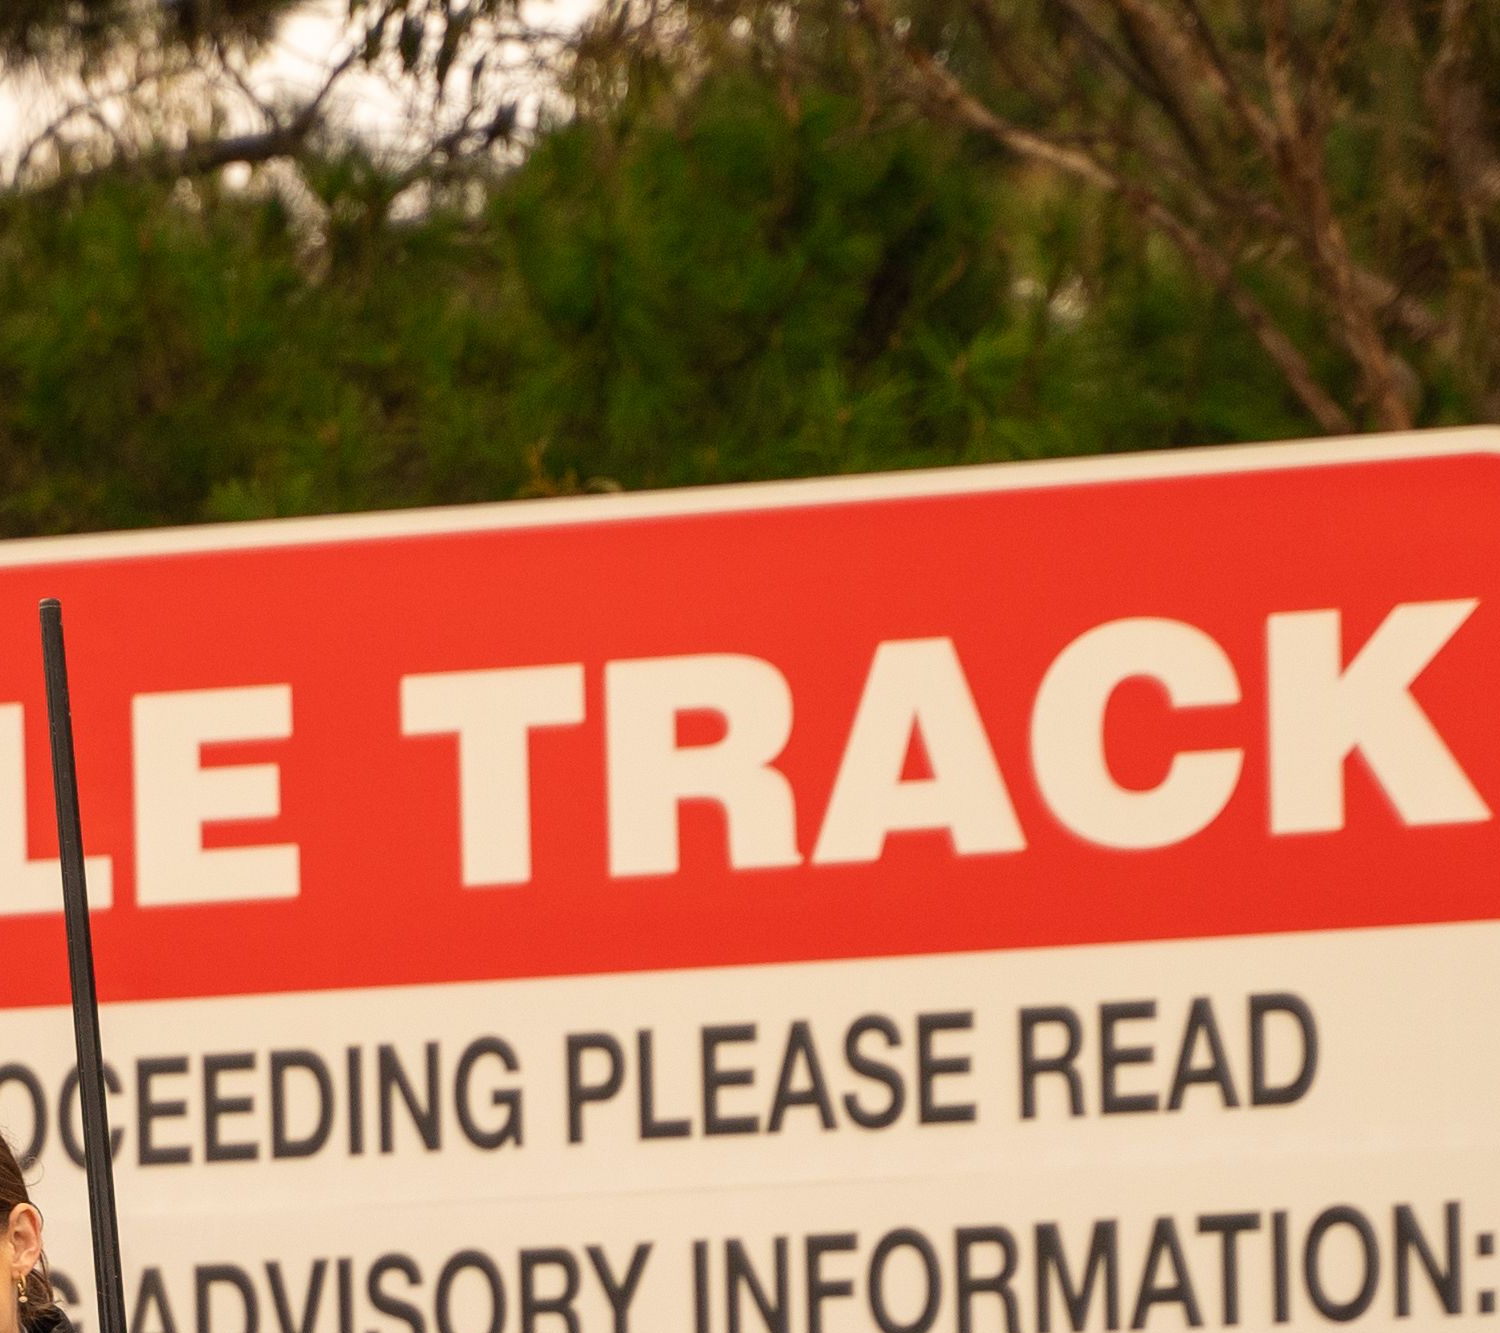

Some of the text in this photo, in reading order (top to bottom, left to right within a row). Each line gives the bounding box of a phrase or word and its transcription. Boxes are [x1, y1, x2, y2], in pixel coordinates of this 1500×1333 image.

[400, 598, 1492, 888] TRACK
[565, 1010, 978, 1142] PLEASE
[1017, 992, 1320, 1120] READ
